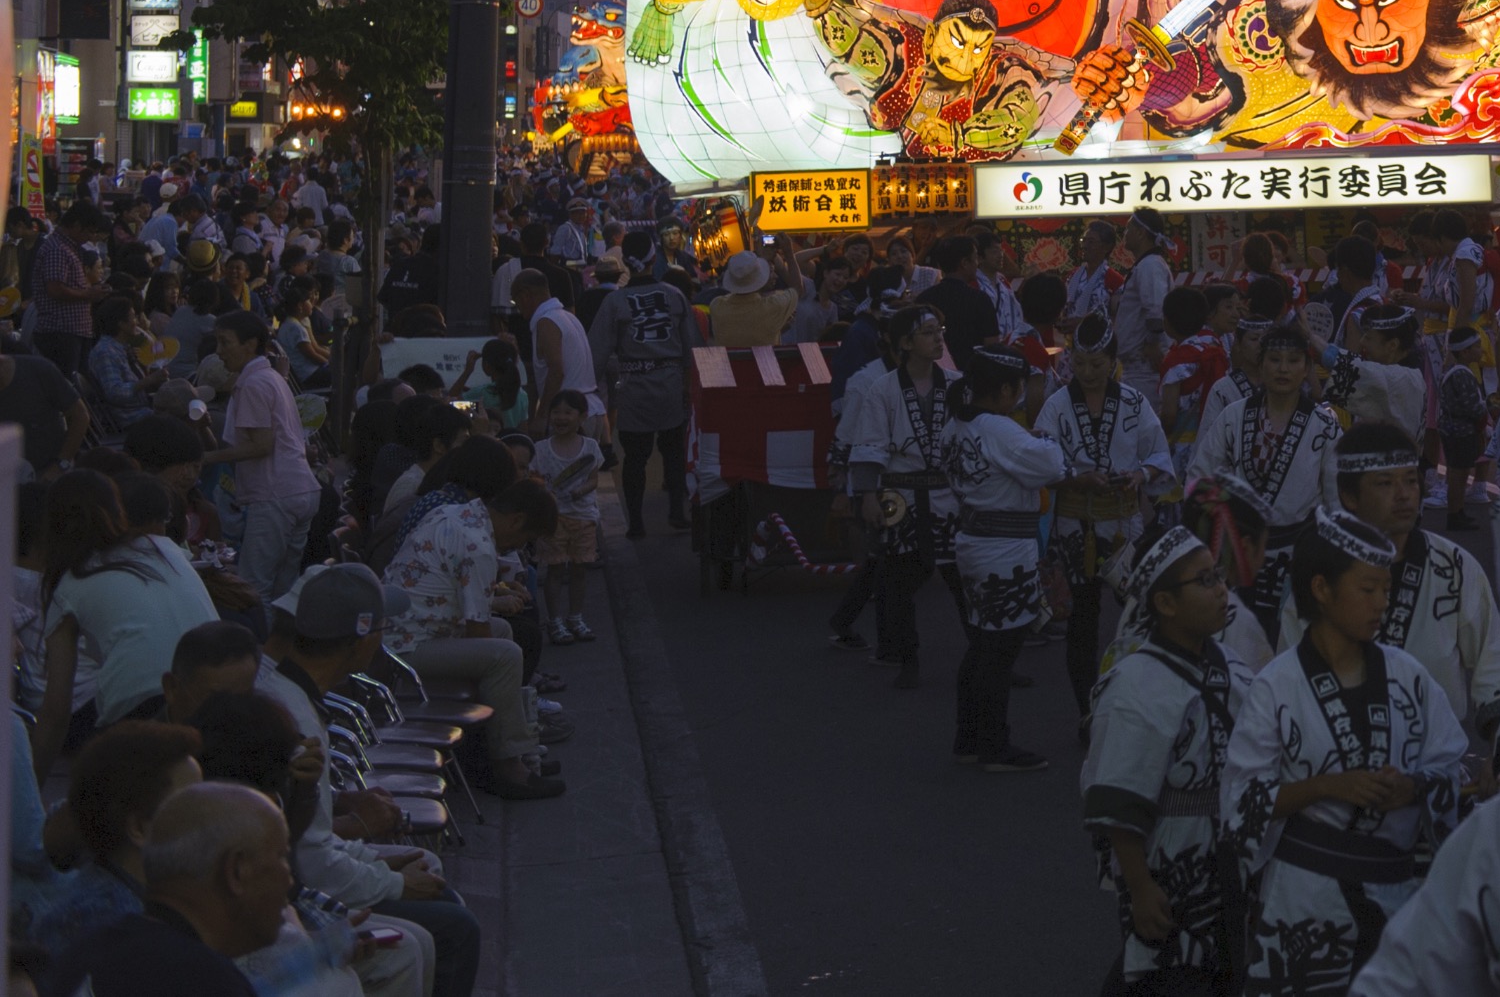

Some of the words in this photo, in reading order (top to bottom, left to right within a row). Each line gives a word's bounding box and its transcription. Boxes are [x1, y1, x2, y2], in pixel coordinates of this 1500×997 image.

[521, 0, 537, 11] 40
[1058, 162, 1447, 206] 県庁ねぶた実行委員会
[769, 193, 858, 213] 妖術合戦
[1206, 215, 1229, 268] 許可
